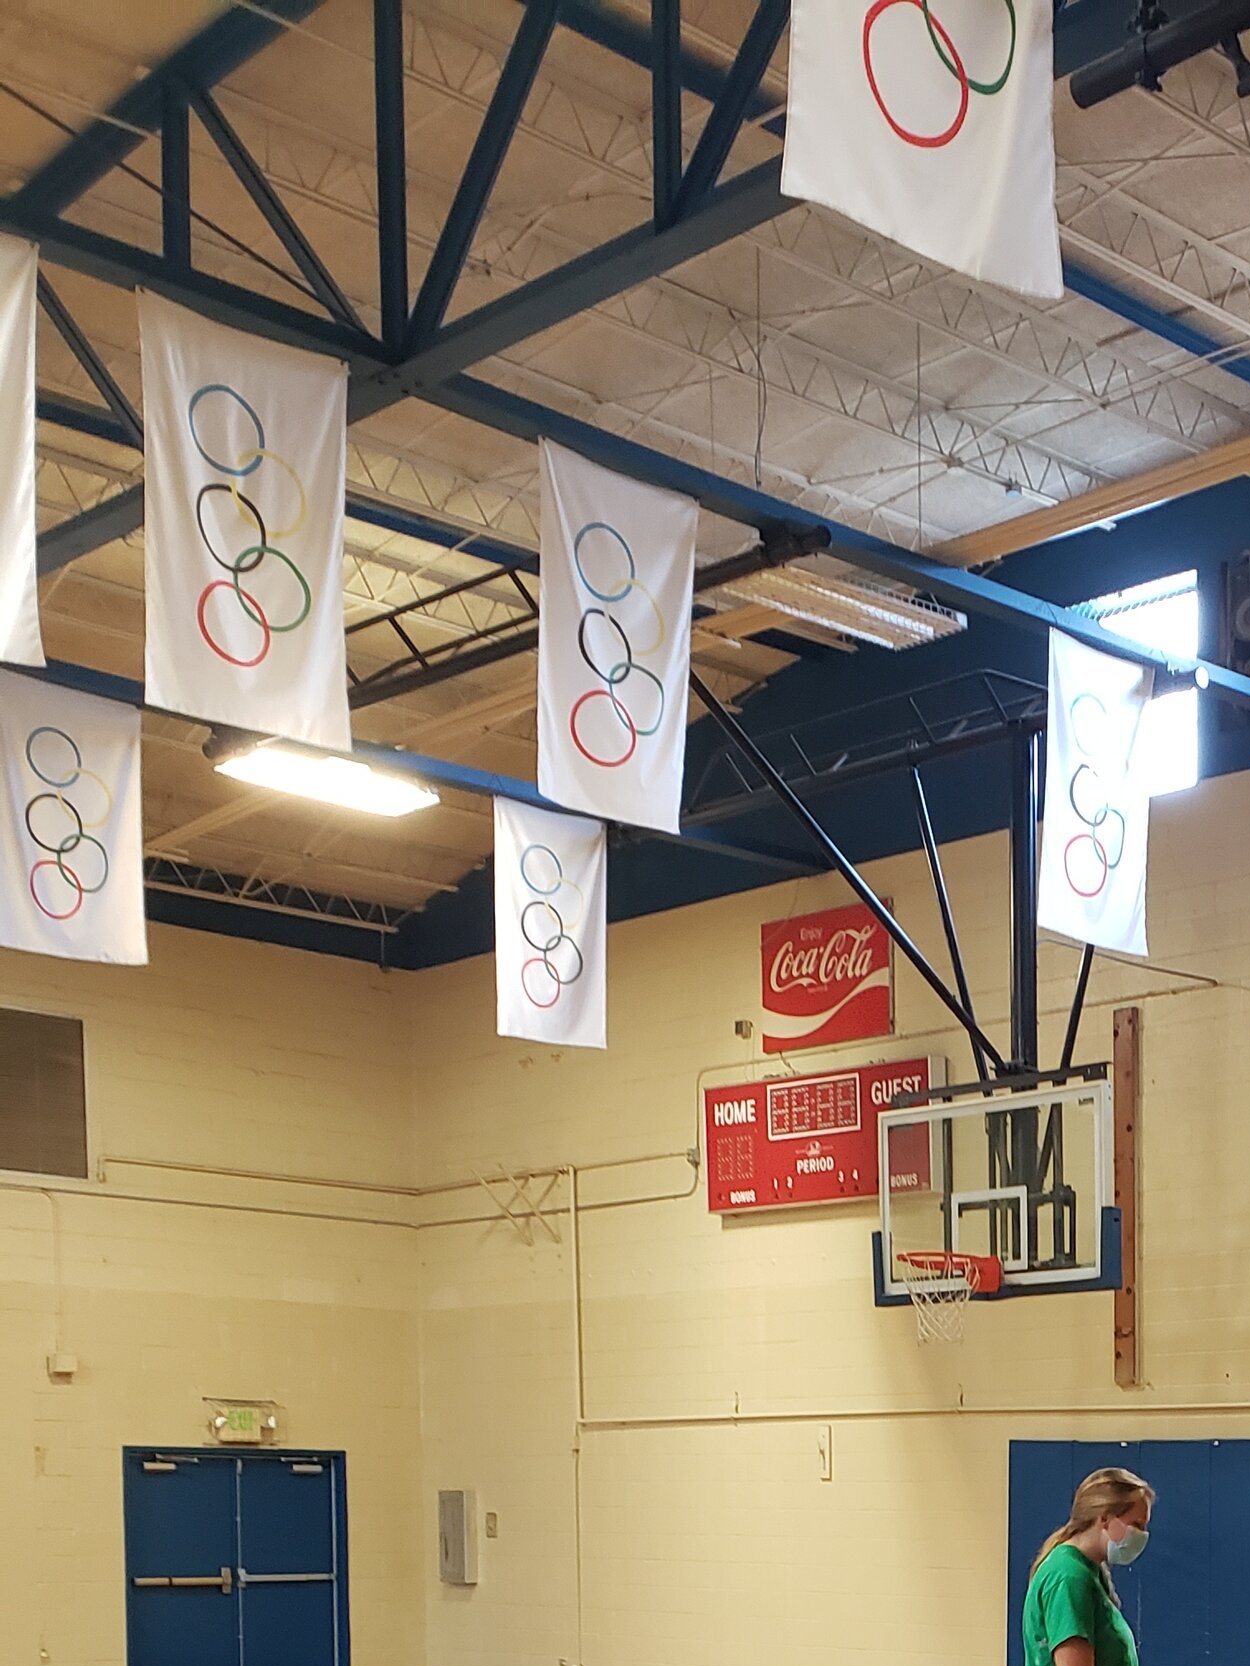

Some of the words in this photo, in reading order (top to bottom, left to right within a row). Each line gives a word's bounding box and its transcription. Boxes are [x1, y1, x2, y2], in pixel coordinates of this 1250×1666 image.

[771, 925, 876, 993] Coca-Cola
[871, 1075, 922, 1105] GUEST
[714, 1099, 756, 1126] HOME
[797, 1156, 834, 1175] PERIOD
[773, 1178, 778, 1190] 1
[787, 1176, 793, 1189] 2
[838, 1170, 844, 1183] 3
[852, 1169, 859, 1181] 4
[891, 1173, 918, 1187] BONUS
[730, 1190, 756, 1204] BONUS
